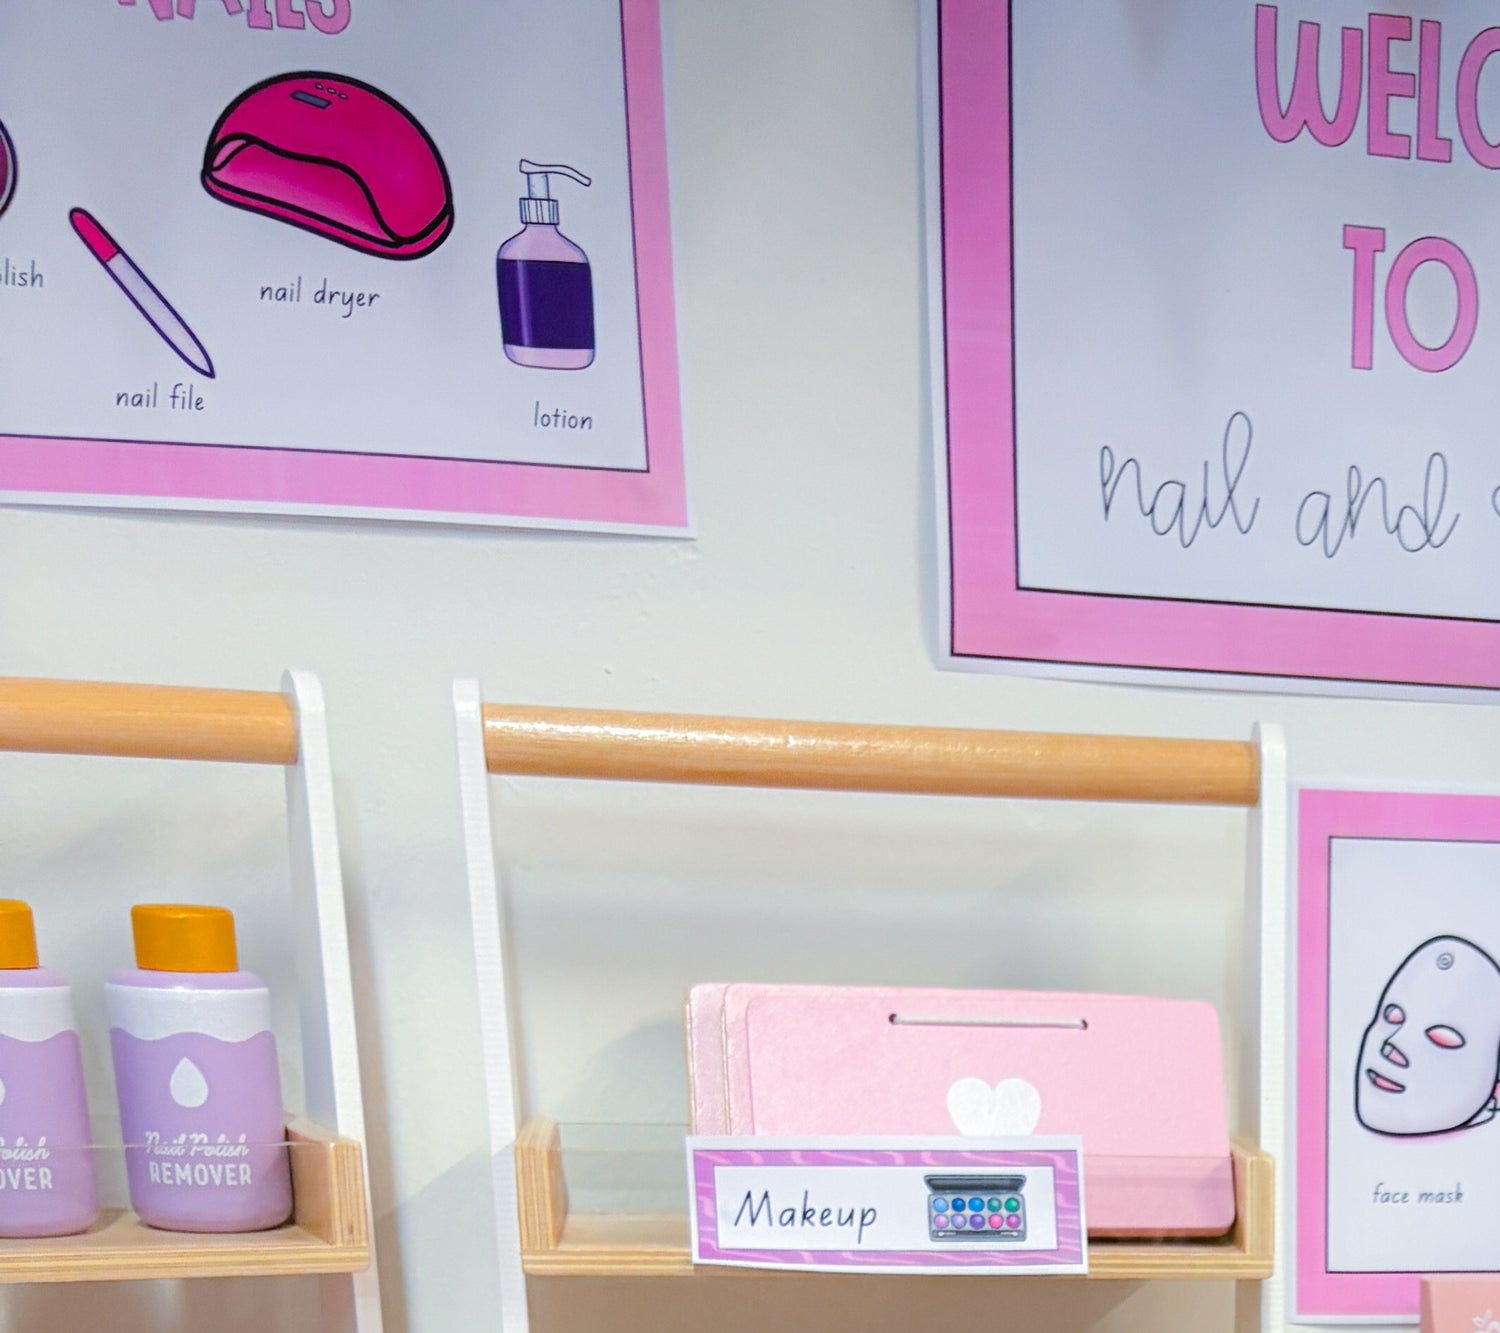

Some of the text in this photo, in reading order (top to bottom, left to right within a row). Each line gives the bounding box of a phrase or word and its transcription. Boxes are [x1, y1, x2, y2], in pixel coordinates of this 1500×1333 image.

[0, 257, 44, 288] lish
[259, 276, 381, 319] nail dryer
[1342, 223, 1479, 374] TO
[115, 381, 205, 412] nail file
[533, 400, 593, 430] lotion
[1098, 411, 1260, 550] nail
[1295, 451, 1460, 558] and
[145, 1131, 250, 1157] Nail Polish
[150, 1162, 252, 1186] REMOVER
[1372, 1182, 1464, 1206] face mask
[733, 1189, 878, 1245] Makeup
